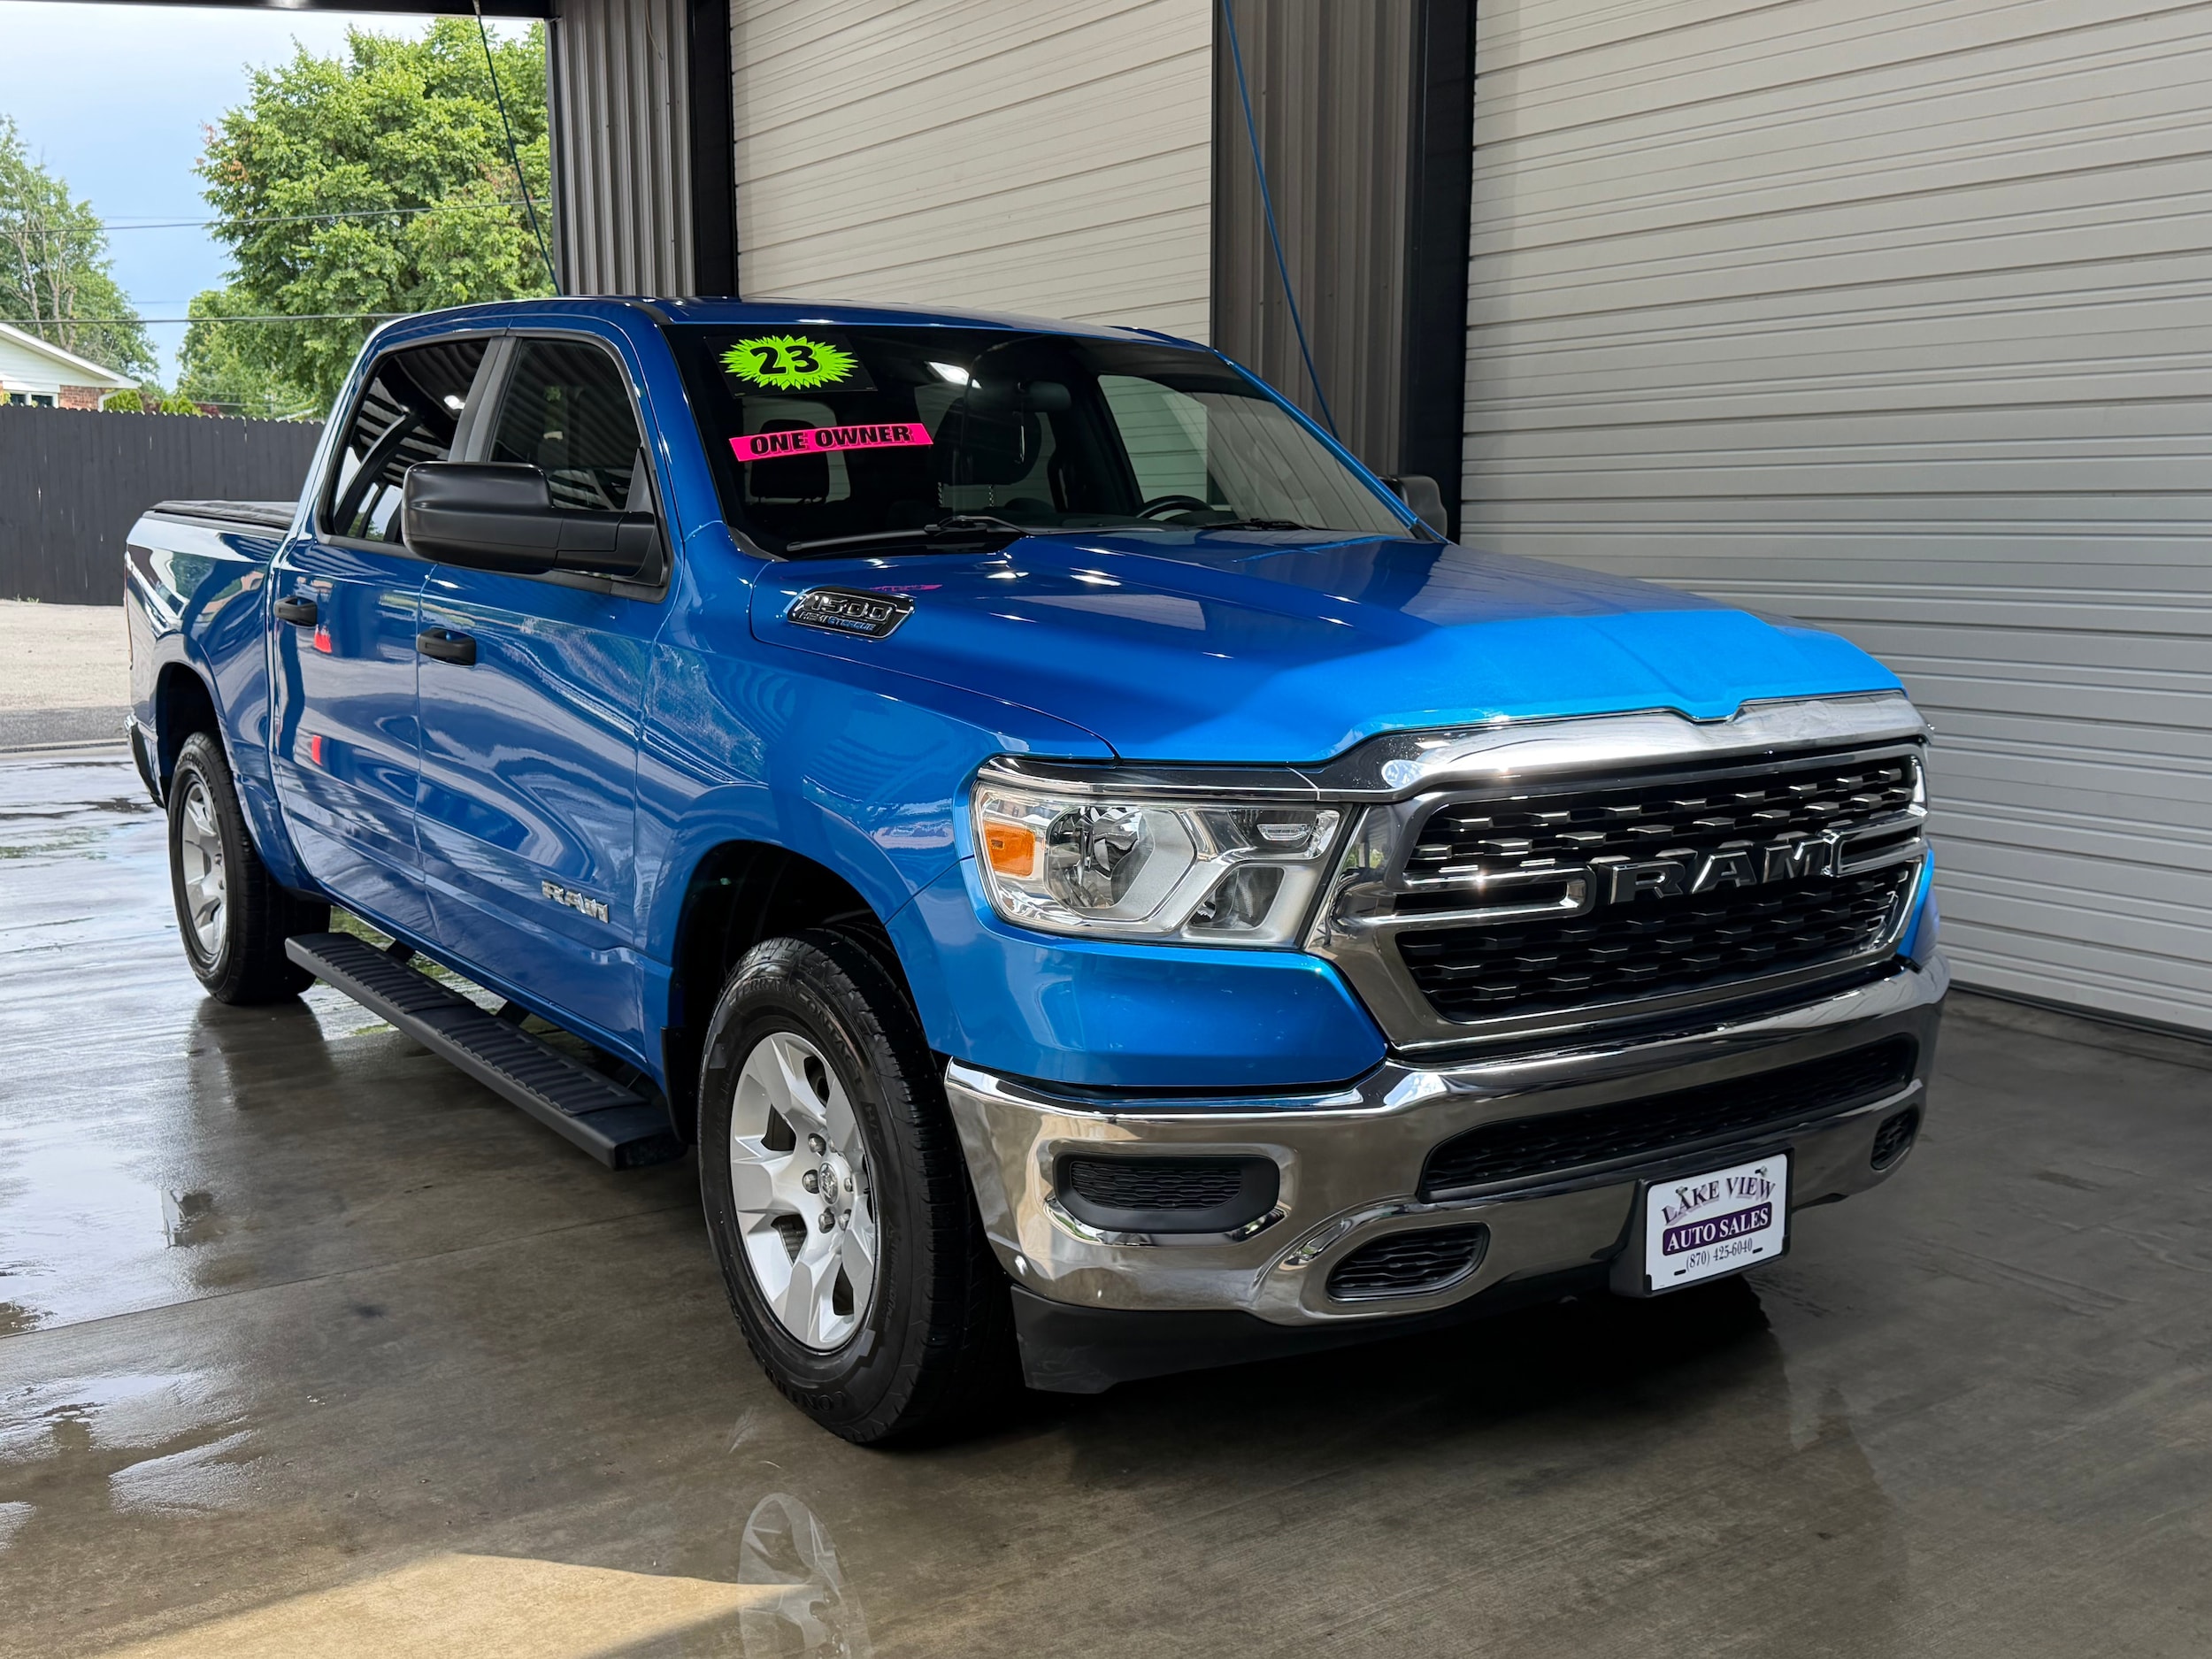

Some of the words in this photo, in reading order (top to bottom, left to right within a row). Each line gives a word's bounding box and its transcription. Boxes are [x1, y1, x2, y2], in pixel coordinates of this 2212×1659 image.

[749, 345, 819, 374] 23
[750, 431, 808, 456] ONE
[815, 426, 915, 449] OWNER
[810, 594, 893, 622] 1500
[1609, 839, 1826, 905] RAM
[541, 879, 609, 924] RAM
[1661, 1179, 1720, 1225] LAKE
[1726, 1176, 1777, 1201] VIEW
[1667, 1223, 1717, 1252] AUTO
[1719, 1207, 1769, 1238] SALES
[1686, 1249, 1710, 1272] (870)
[1712, 1237, 1753, 1262] 425-6040
